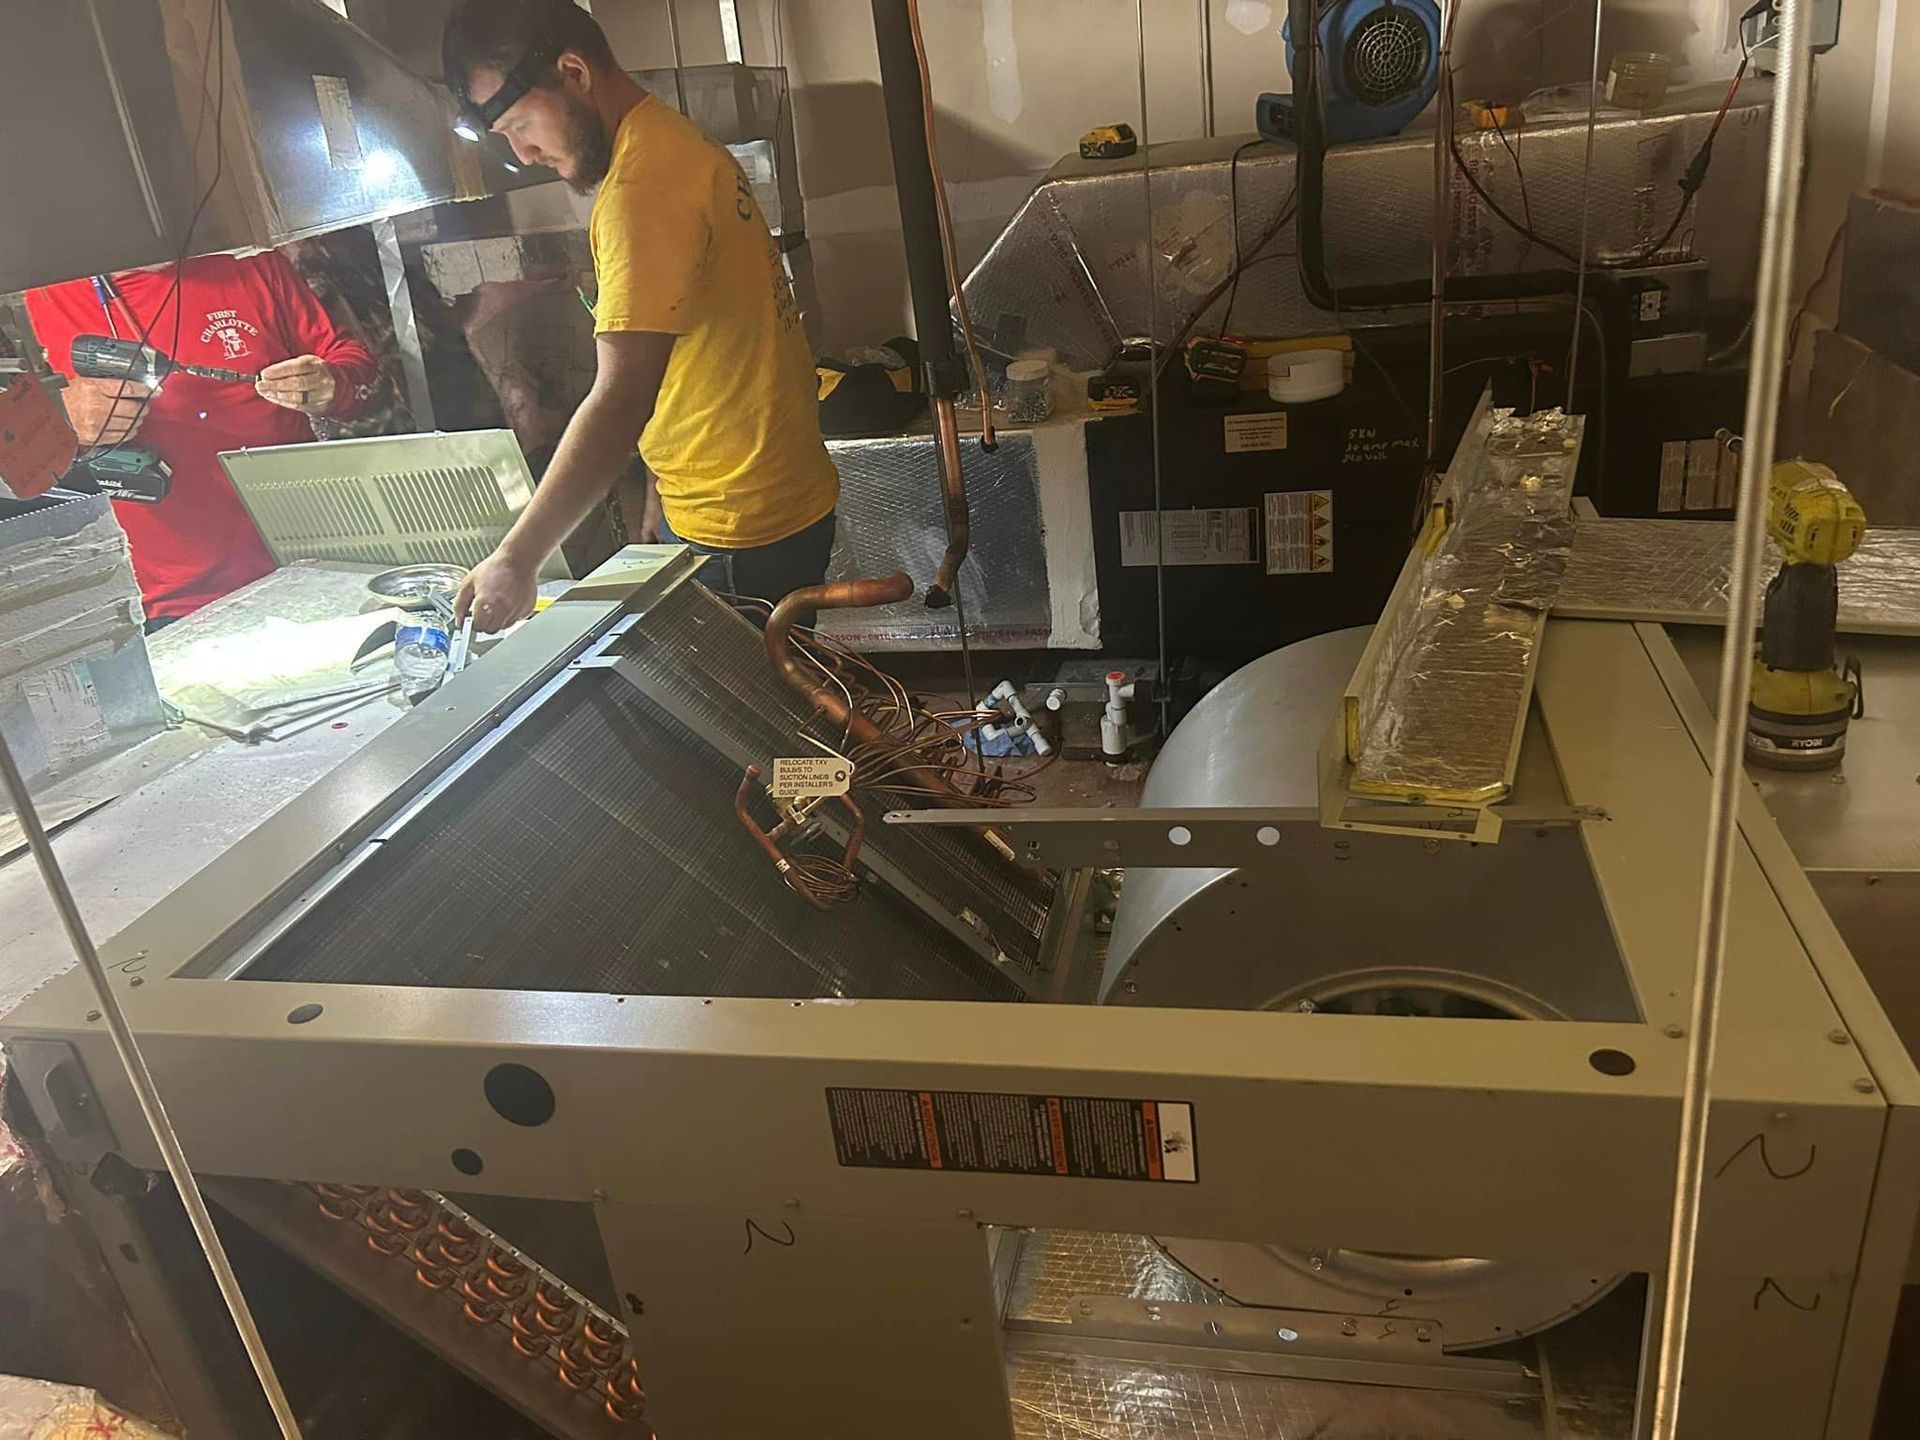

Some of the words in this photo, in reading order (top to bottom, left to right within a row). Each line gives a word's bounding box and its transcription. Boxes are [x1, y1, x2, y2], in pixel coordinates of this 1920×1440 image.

[206, 310, 237, 321] FIRST
[200, 318, 259, 343] CHARLOTTE
[96, 479, 124, 488] akita
[1792, 738, 1823, 748] RYOBI
